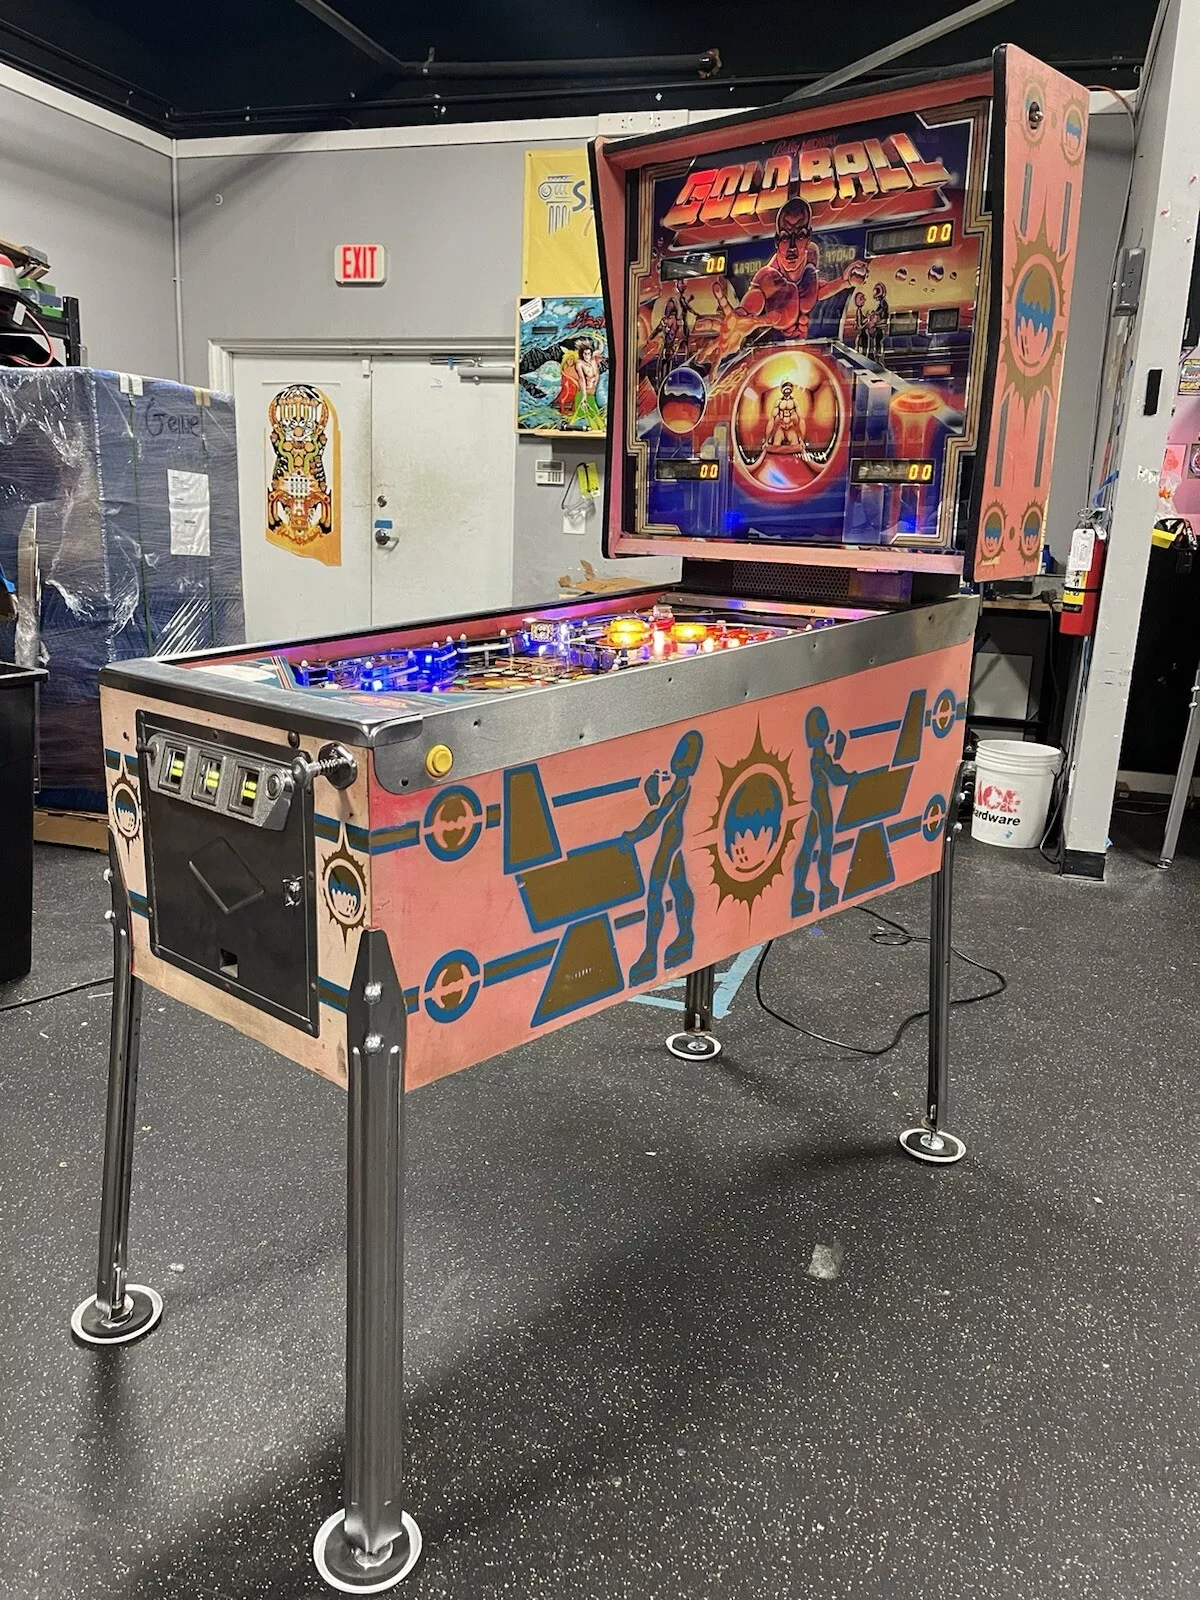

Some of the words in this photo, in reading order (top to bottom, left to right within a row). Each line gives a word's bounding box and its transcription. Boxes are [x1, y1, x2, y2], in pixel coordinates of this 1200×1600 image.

[662, 155, 793, 226] GOLD
[799, 132, 951, 203] BALL
[343, 246, 378, 279] EXIT
[973, 808, 1021, 826] ardware
